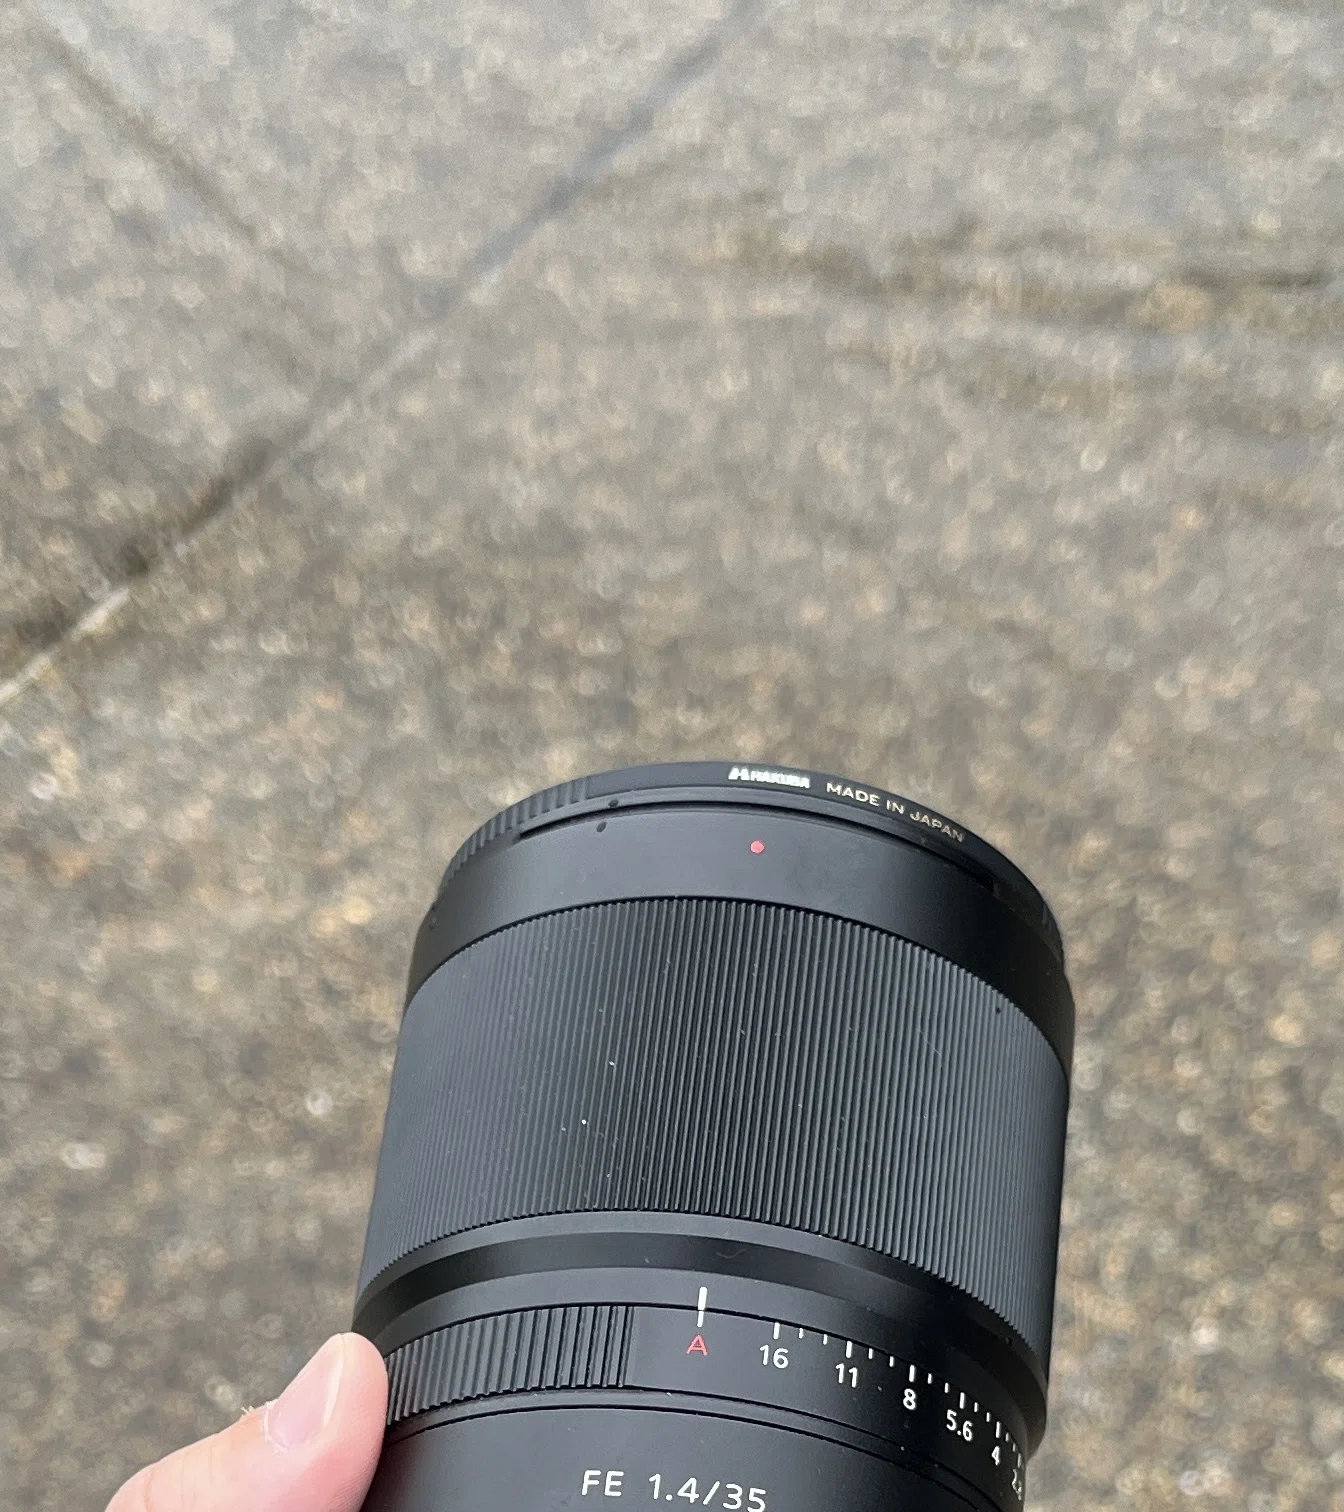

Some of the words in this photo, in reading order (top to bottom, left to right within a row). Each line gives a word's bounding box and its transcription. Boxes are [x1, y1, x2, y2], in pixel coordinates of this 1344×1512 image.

[826, 782, 880, 806] MADE
[886, 799, 905, 815] IN
[910, 811, 965, 843] JAPAN
[686, 1335, 708, 1356] A
[760, 1344, 789, 1369] 16
[835, 1363, 858, 1388] 11
[902, 1388, 917, 1410] 8
[946, 1409, 973, 1442] 5.6
[991, 1446, 1001, 1466] 4
[581, 1469, 625, 1497] FE
